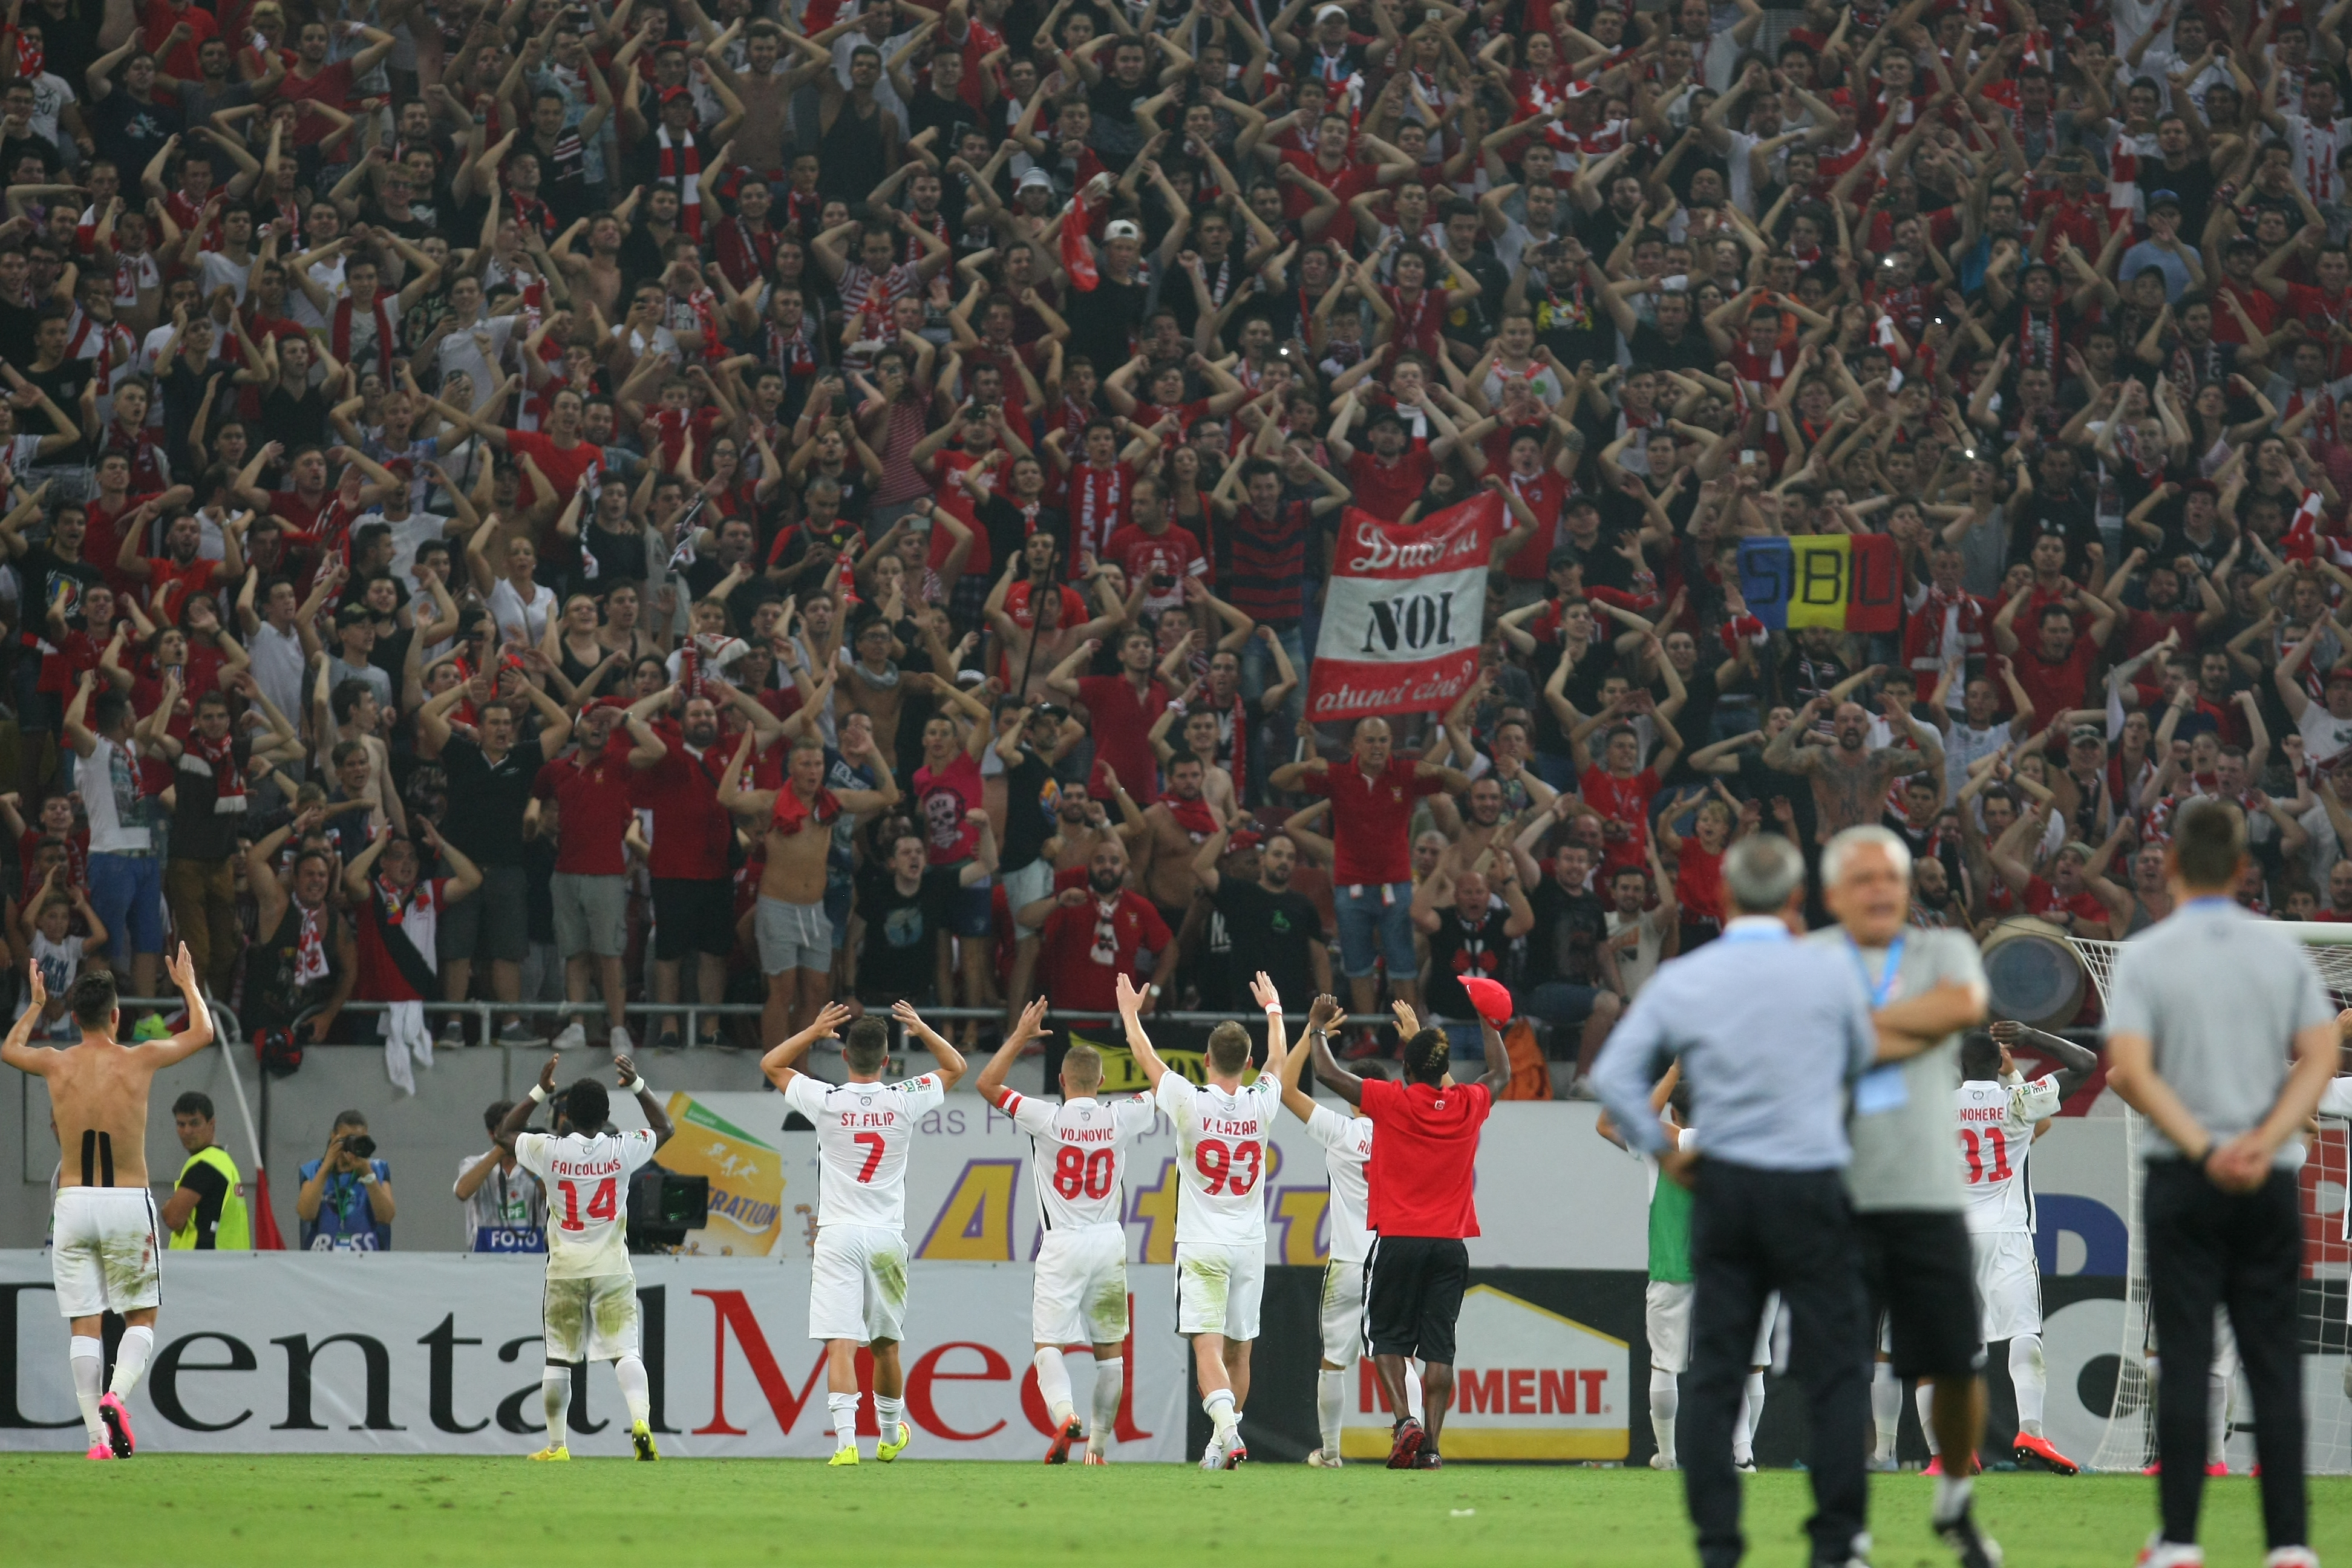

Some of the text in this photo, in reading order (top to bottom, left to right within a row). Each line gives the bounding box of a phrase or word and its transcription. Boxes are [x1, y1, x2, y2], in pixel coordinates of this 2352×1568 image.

[1315, 659, 1474, 713] atunci cine?
[840, 1111, 895, 1127] ST. FILIP
[1203, 1117, 1258, 1135] V. LAZAR
[1958, 1106, 2004, 1122] NOHERE
[1060, 1127, 1114, 1143] VOJNOVIC
[574, 1158, 621, 1175] COLLINS
[854, 1131, 885, 1184] 7
[1053, 1145, 1116, 1200] 80
[1195, 1139, 1262, 1196] 93
[1957, 1126, 2013, 1185] 31
[557, 1177, 616, 1231] 14
[310, 1232, 374, 1252] PRSS
[491, 1230, 538, 1248] FOTO
[1359, 1356, 1607, 1414] MMENT
